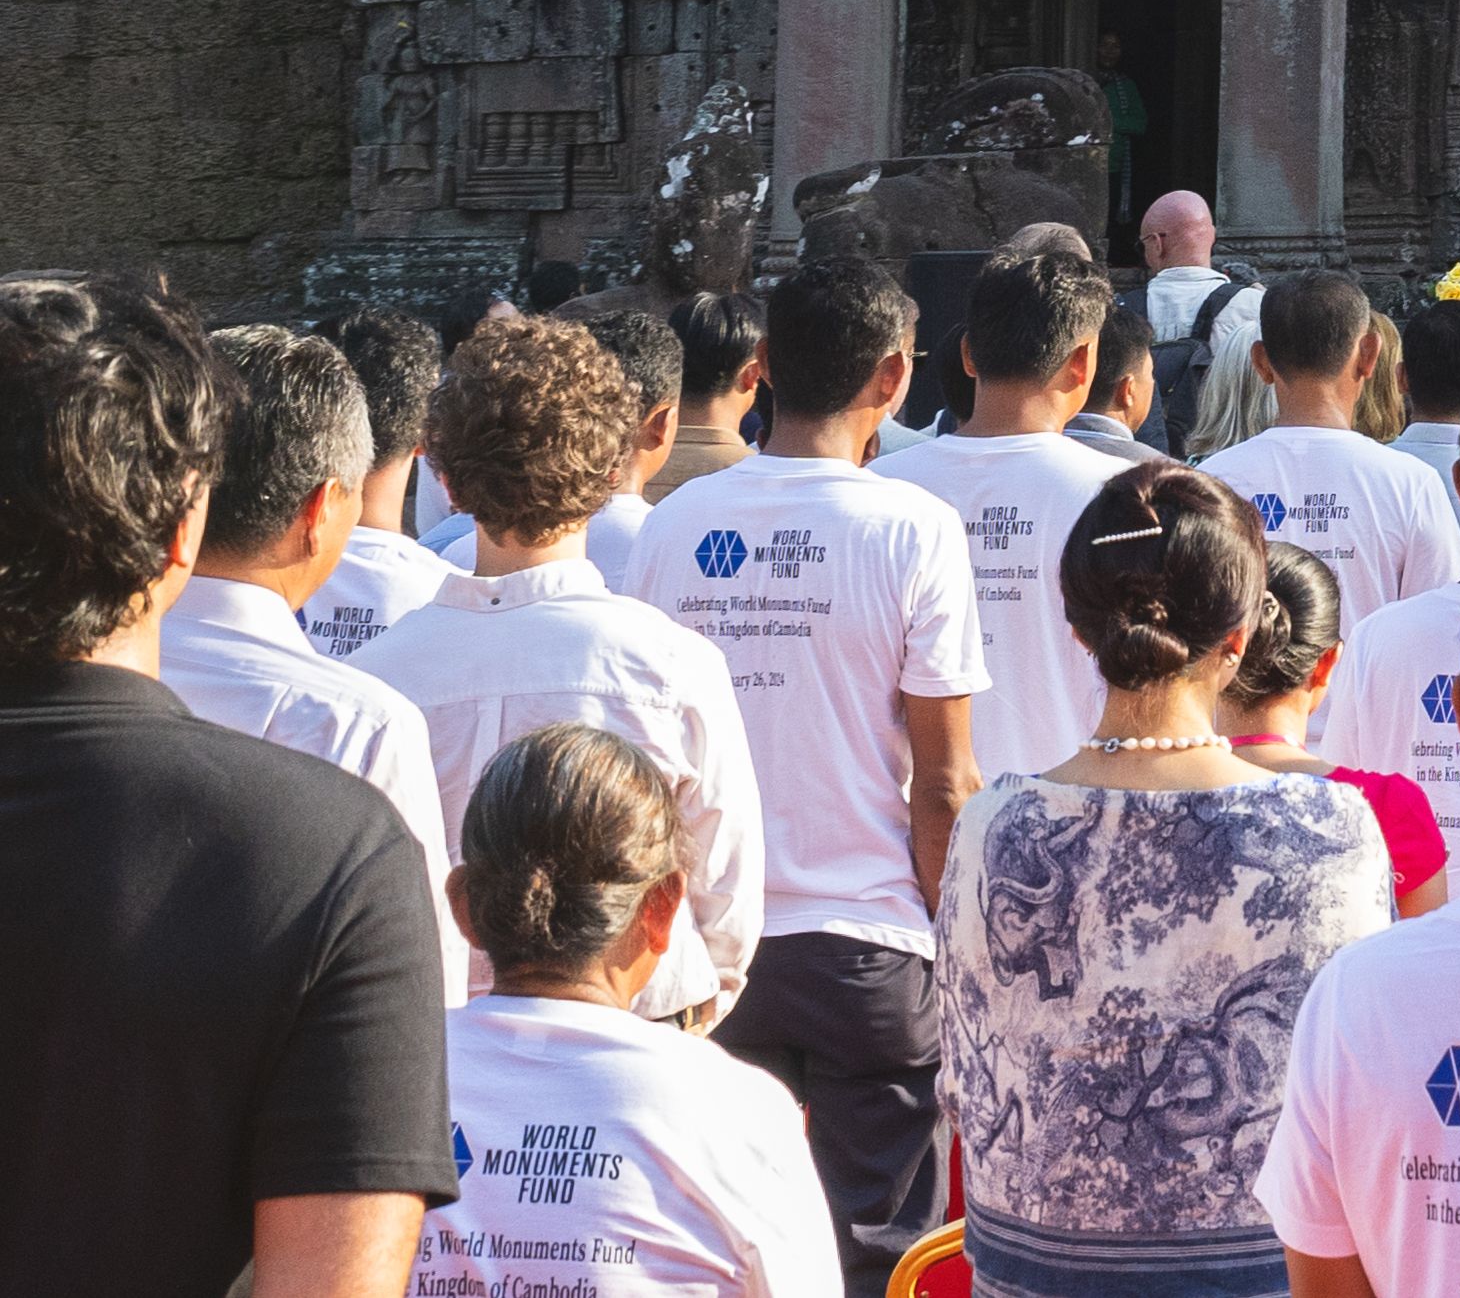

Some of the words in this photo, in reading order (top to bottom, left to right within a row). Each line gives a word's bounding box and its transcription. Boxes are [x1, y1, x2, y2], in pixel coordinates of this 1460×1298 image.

[1304, 493, 1336, 506] WORLD
[982, 507, 1018, 520] WORLD
[1288, 506, 1350, 520] MONUMENTS
[966, 521, 1033, 536] MONUMENTS
[1305, 520, 1328, 532] FUND
[772, 530, 812, 545] WORLD
[984, 536, 1008, 550] FUND
[771, 563, 800, 578] FUND
[807, 598, 832, 614] Fund
[334, 607, 374, 623] WORLD
[694, 621, 705, 636] in
[762, 620, 772, 636] of
[1417, 766, 1425, 781] in
[1429, 766, 1442, 782] the
[521, 1124, 597, 1150] WORLD
[482, 1149, 623, 1180] MONUMENTS
[518, 1178, 575, 1204] FUND
[1426, 1196, 1438, 1221] in
[439, 1230, 485, 1257] World
[489, 1234, 587, 1263] Monuments
[592, 1238, 636, 1265] Fund
[417, 1271, 486, 1298] Kingdom
[490, 1274, 511, 1298] of
[512, 1276, 597, 1298] Cambodia
